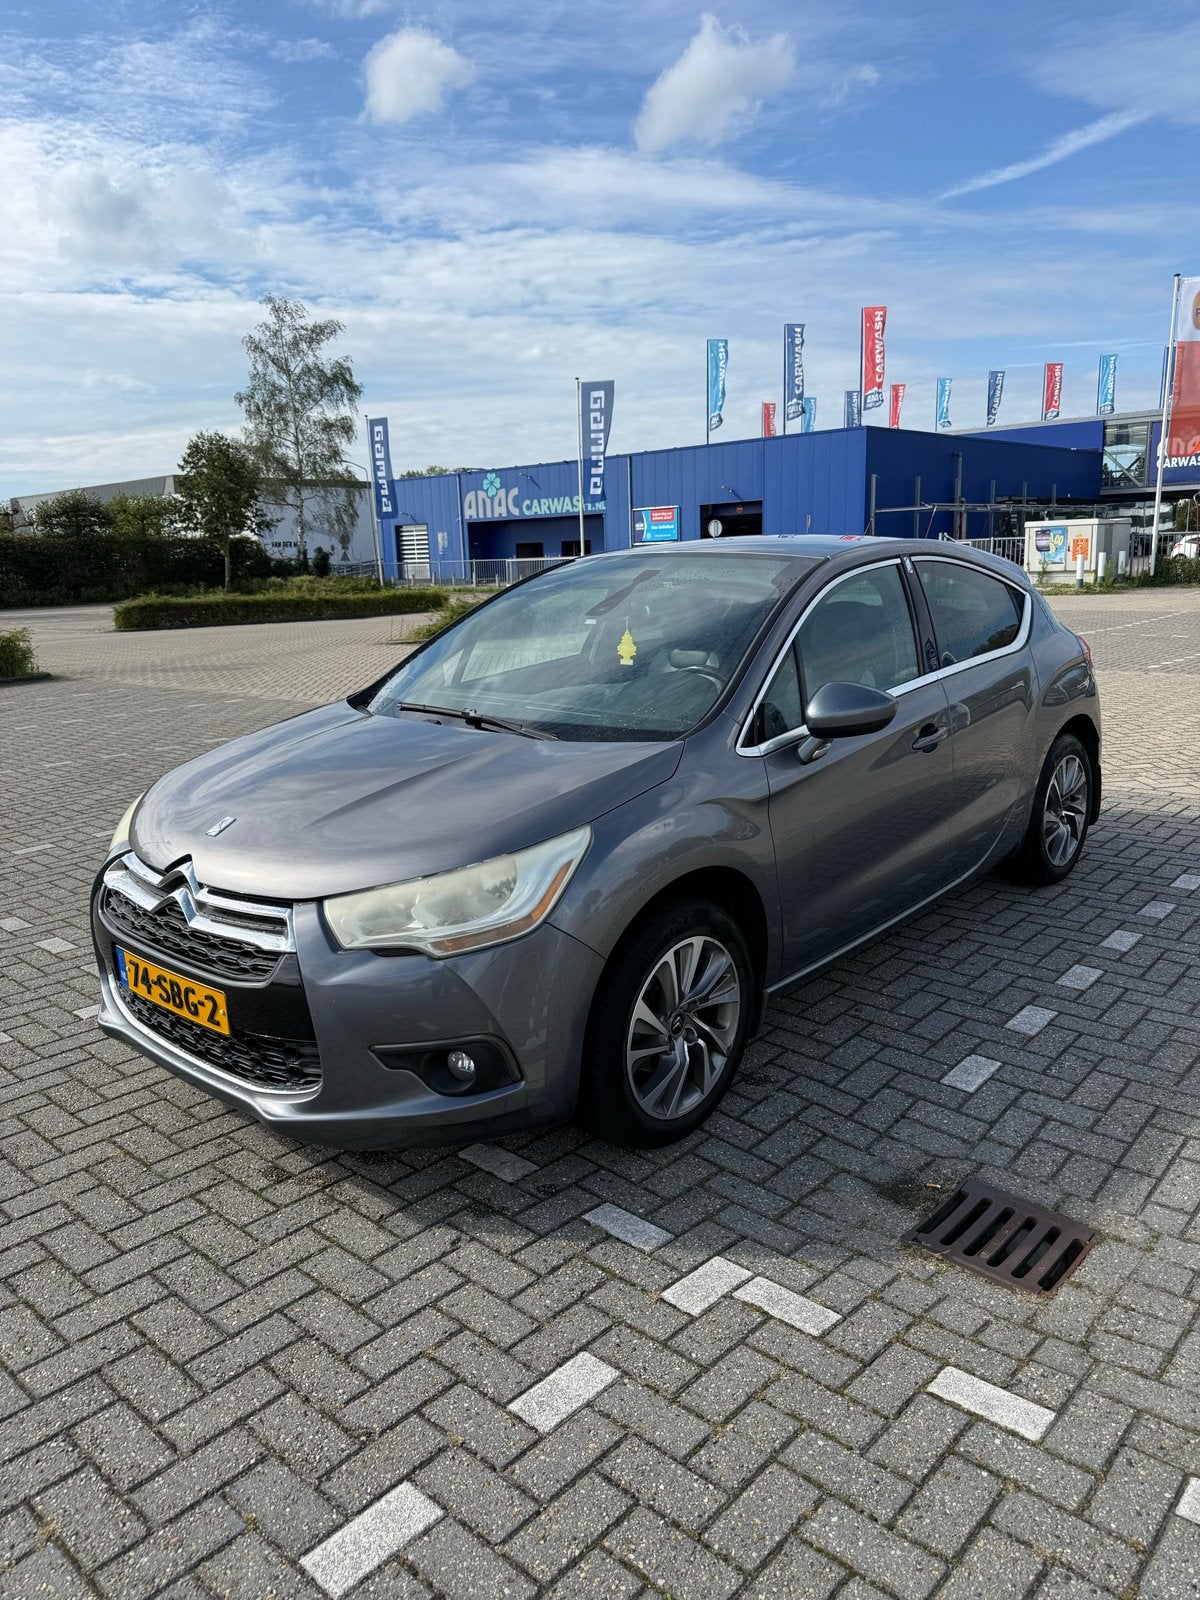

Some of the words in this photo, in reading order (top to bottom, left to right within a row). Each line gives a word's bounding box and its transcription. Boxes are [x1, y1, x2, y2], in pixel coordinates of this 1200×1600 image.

[794, 327, 803, 395] CARWASH
[874, 310, 884, 383] CARWASH
[991, 372, 1004, 414] CARWASH
[1052, 364, 1062, 406] CARWASH
[522, 495, 606, 516] CARWAS.NL
[128, 959, 221, 1027] 74-SBG-2
